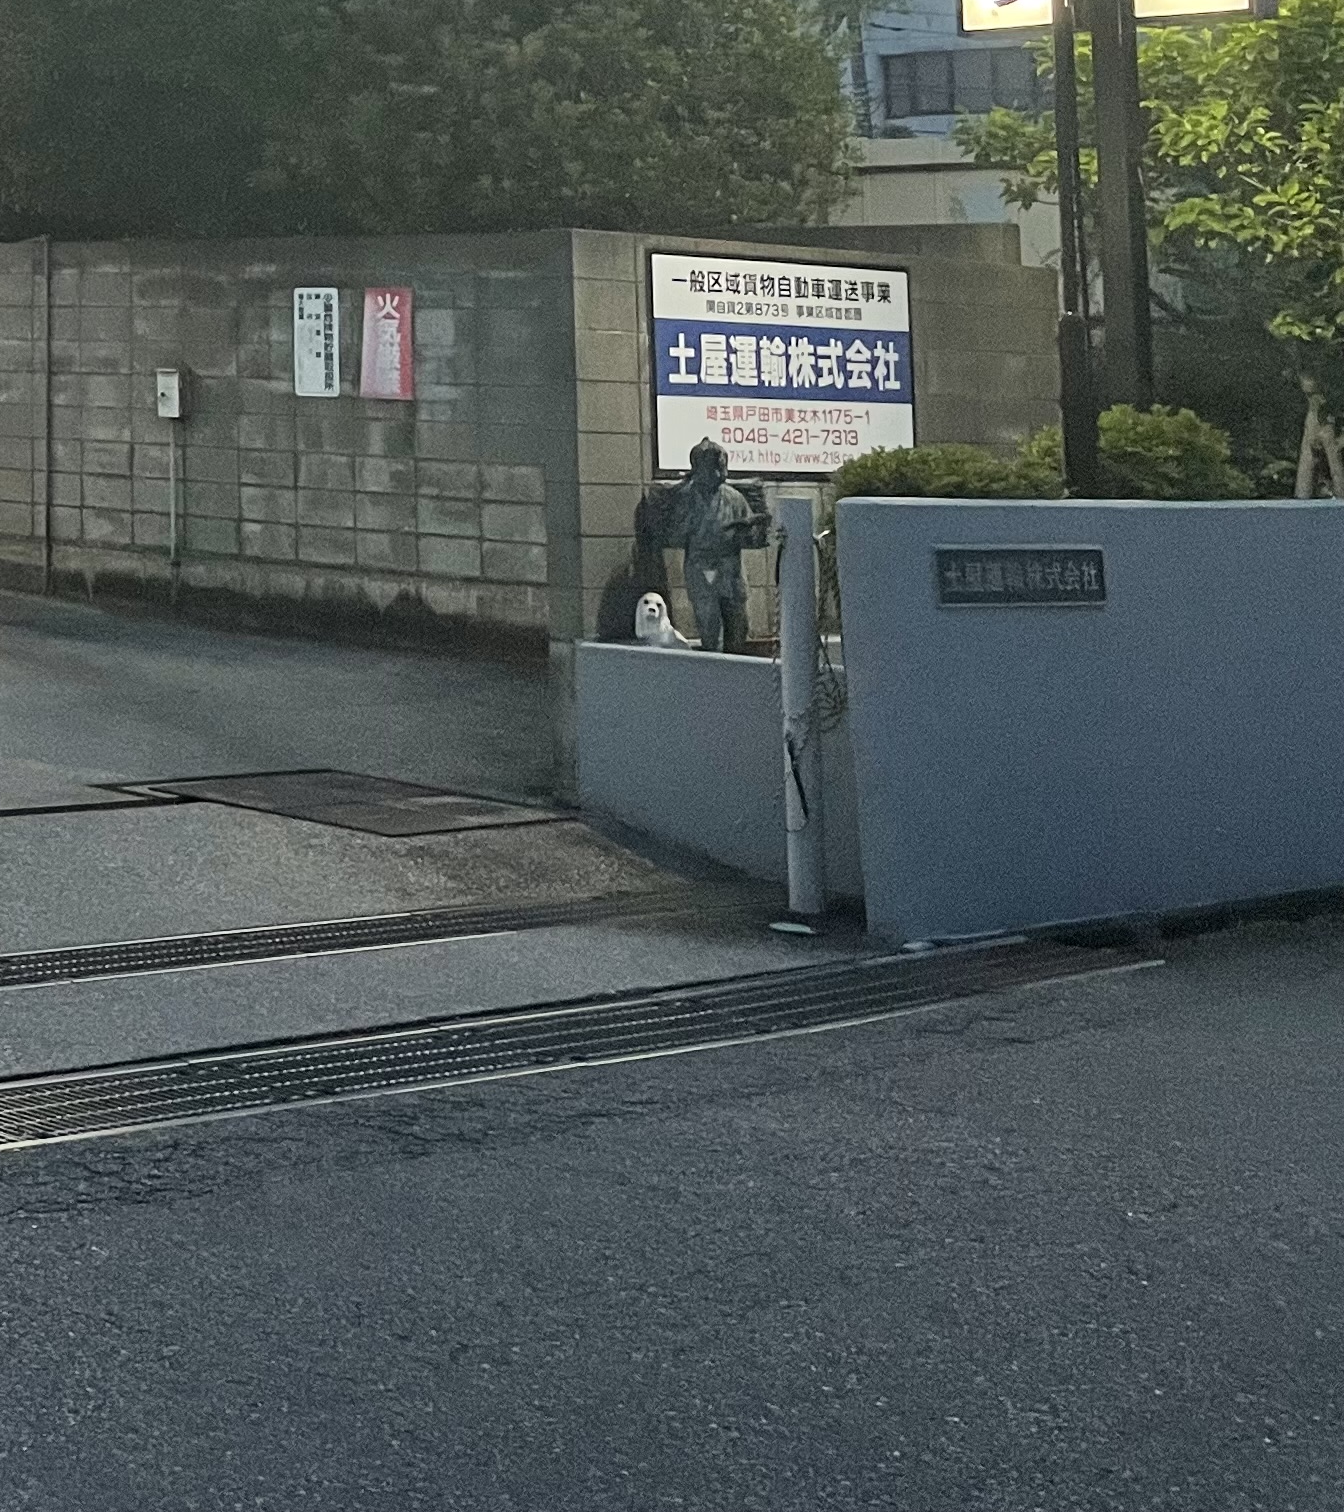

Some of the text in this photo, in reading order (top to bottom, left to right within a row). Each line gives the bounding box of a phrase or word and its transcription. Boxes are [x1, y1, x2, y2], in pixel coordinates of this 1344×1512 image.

[672, 270, 892, 304] 一般区域貨物自動車運送事業
[668, 332, 902, 392] 土屋運輸株式会社
